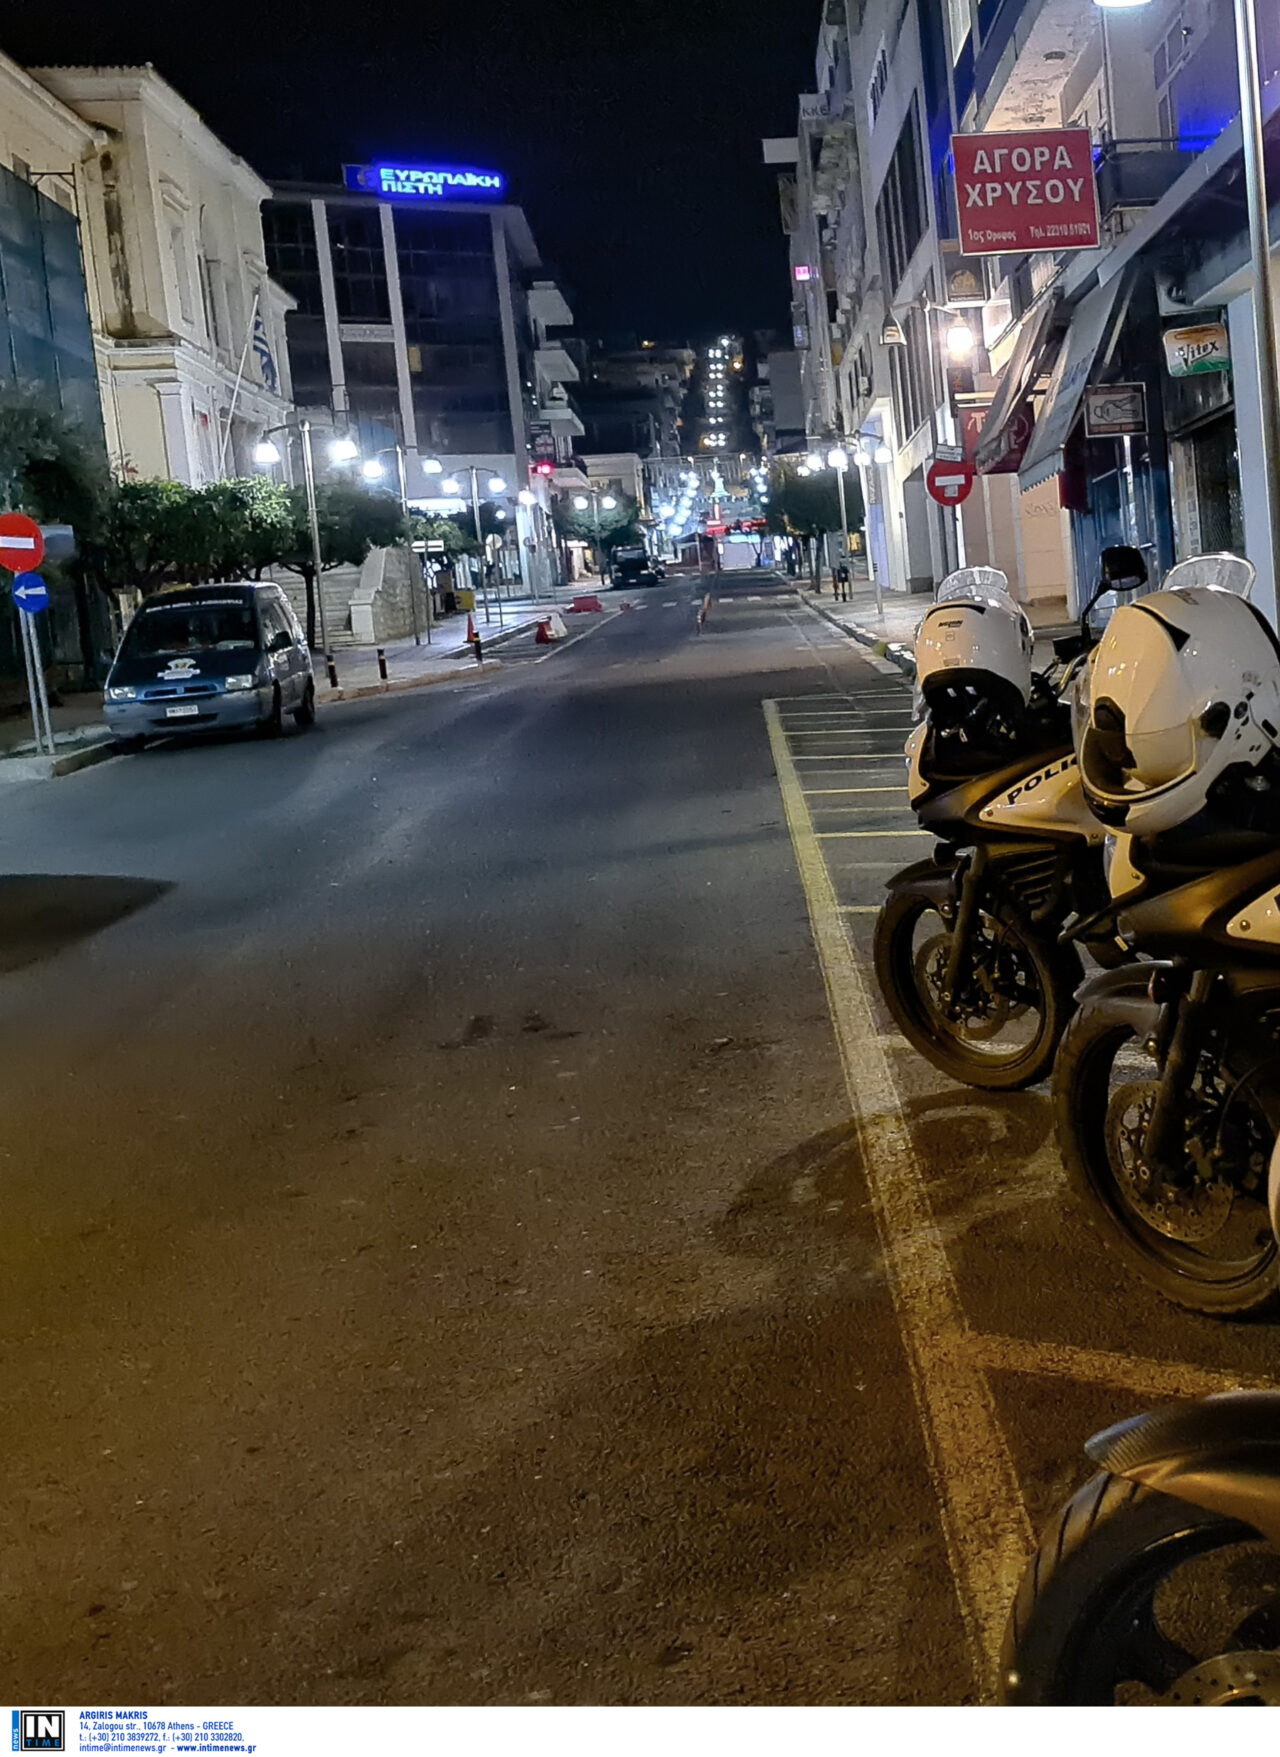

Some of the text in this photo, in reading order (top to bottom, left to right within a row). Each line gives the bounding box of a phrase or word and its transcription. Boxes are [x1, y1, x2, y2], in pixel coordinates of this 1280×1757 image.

[973, 145, 1073, 174] ΑΓΟΡΑ
[382, 180, 443, 195] ΠΙΣΤΗ
[964, 178, 1085, 208] ΧΡΥΣΟΥ
[1178, 341, 1219, 368] Vitex
[1007, 755, 1078, 805] POLI
